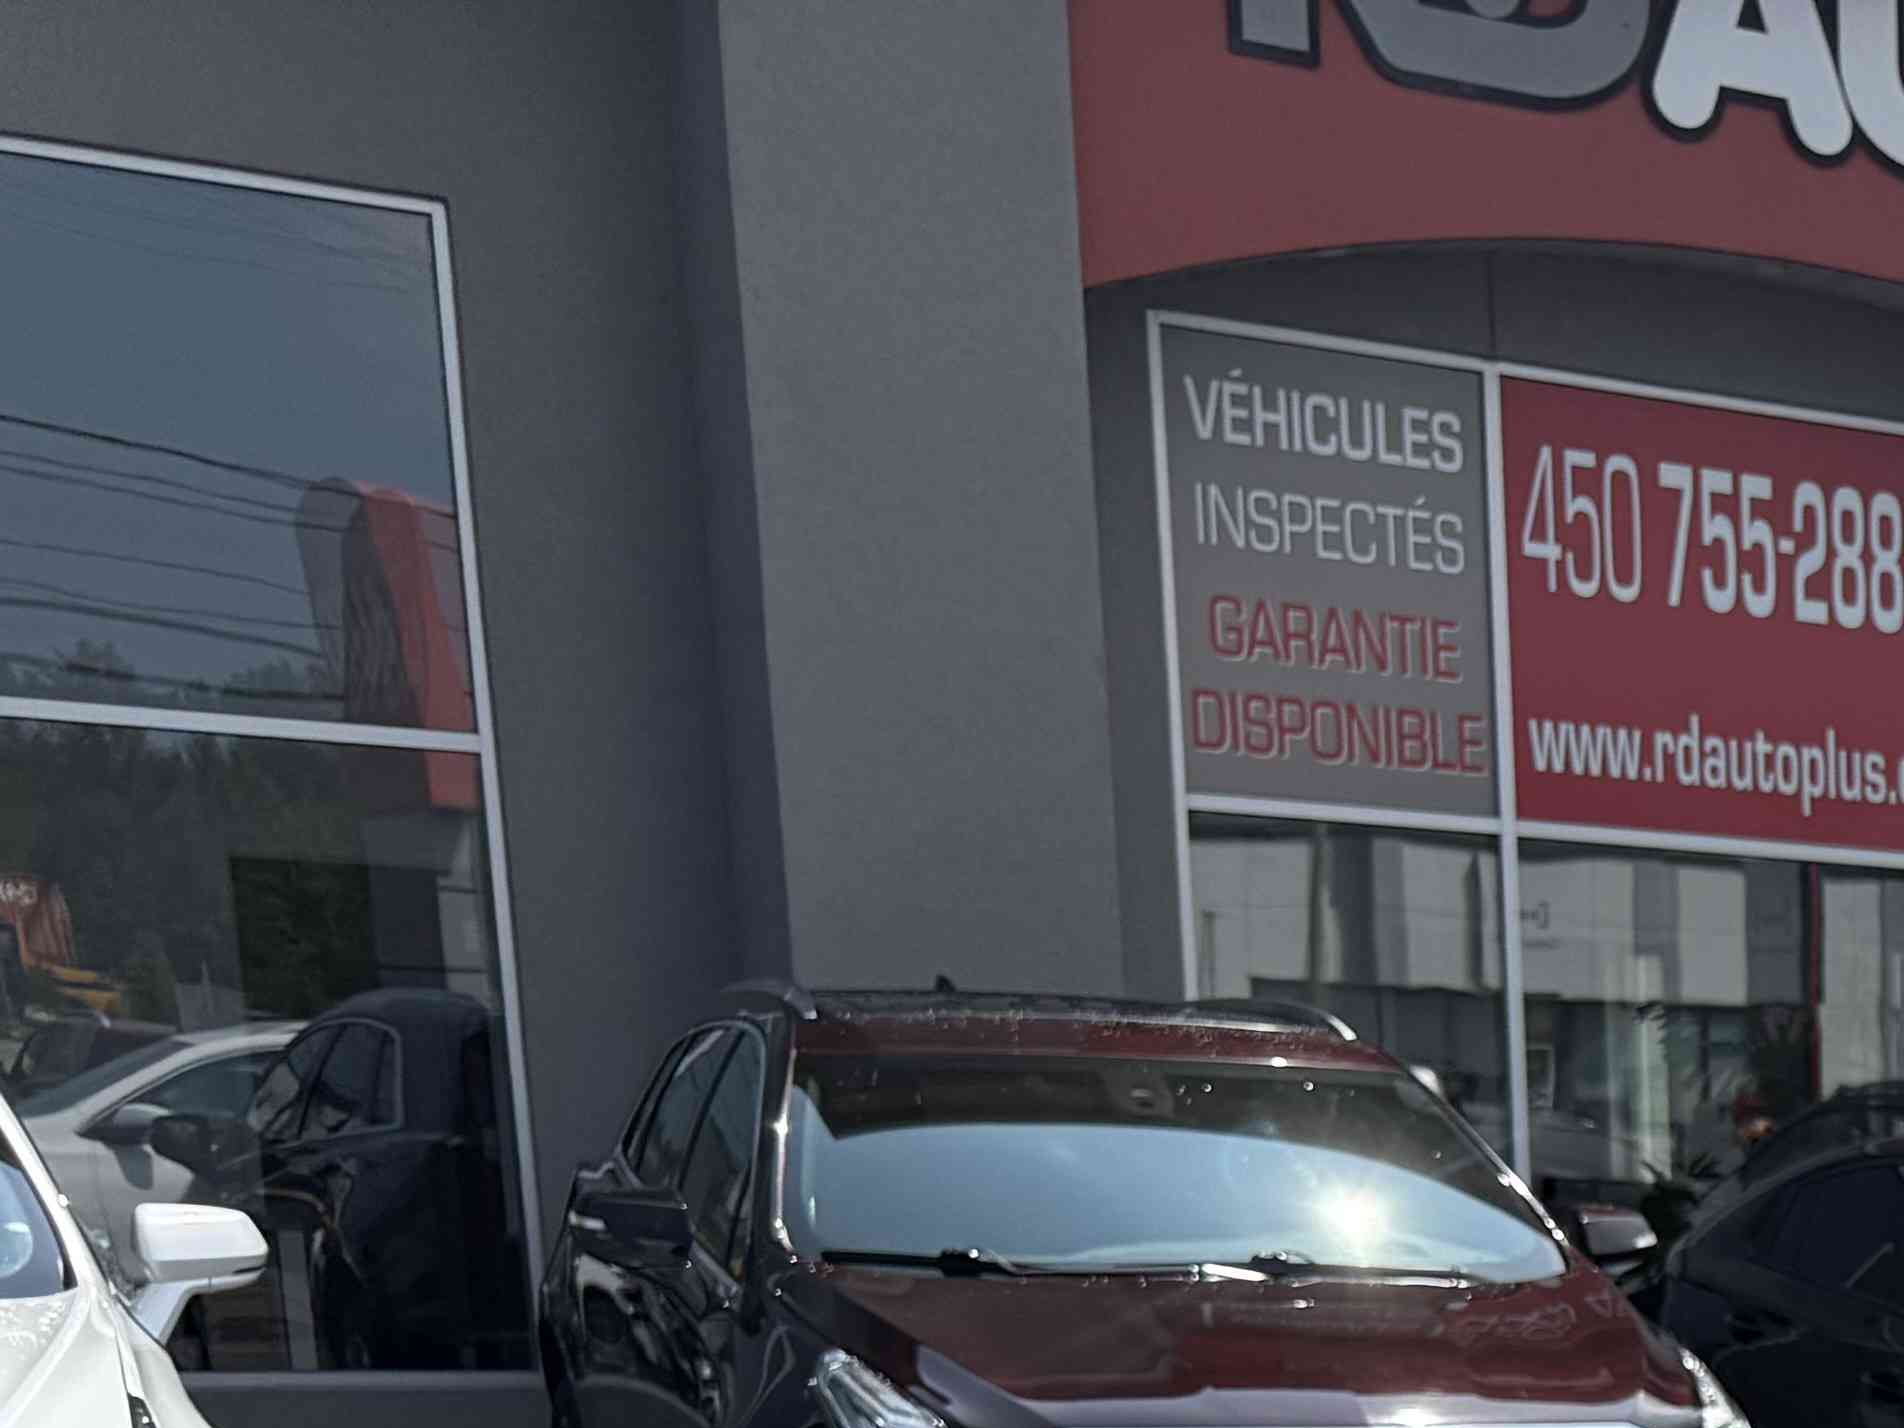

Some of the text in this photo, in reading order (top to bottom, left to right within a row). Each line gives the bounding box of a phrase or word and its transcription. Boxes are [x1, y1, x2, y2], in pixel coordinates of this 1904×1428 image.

[1183, 368, 1464, 473] VÉHICULES
[1194, 482, 1465, 574] INSPECTÉS
[1521, 445, 1643, 602] 450
[1207, 595, 1463, 684] GARANTIE
[1190, 687, 1489, 777] DISPONIBLE
